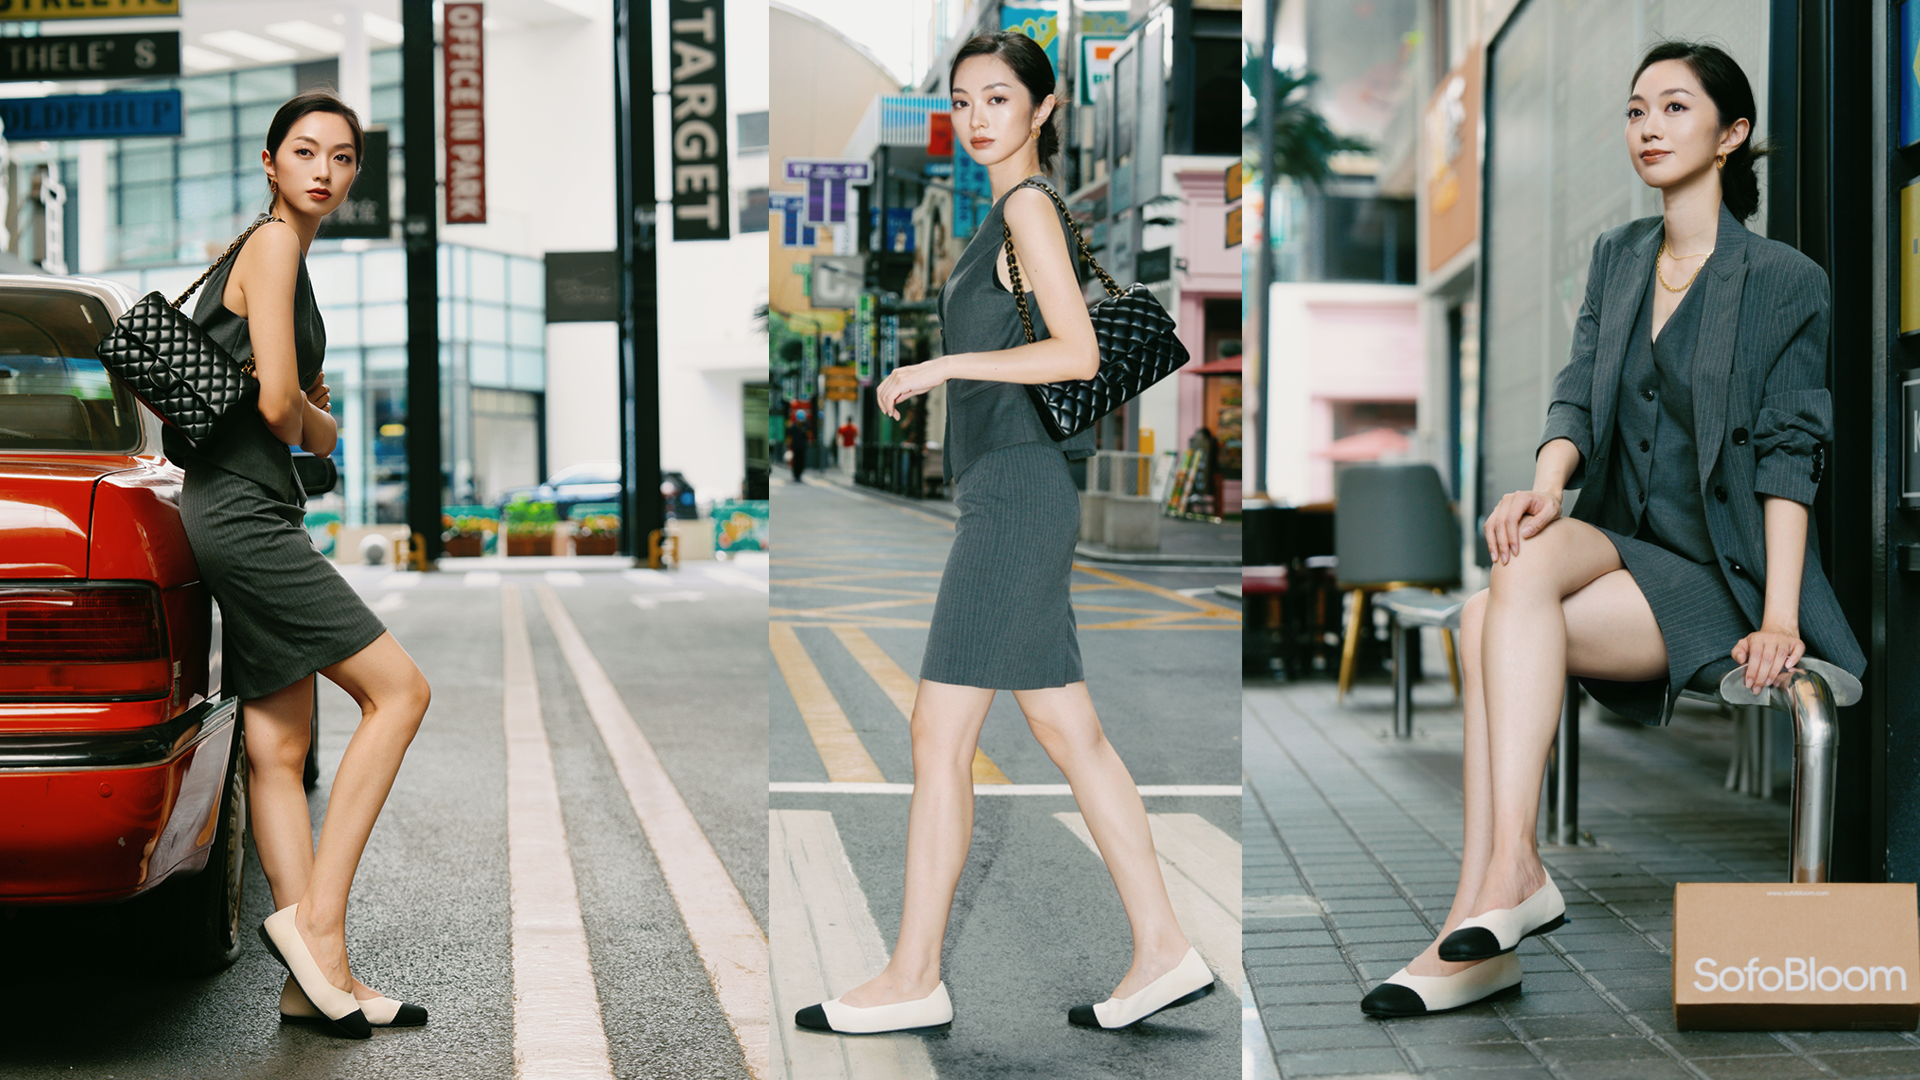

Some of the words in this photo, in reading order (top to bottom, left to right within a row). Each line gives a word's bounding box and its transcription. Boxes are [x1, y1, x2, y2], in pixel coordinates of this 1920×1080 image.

[448, 6, 481, 106] OFFICE
[450, 109, 481, 140] IN
[672, 0, 720, 231] TARGET
[450, 144, 482, 219] PARK
[1766, 889, 1830, 897] www.sofobloom.com
[1693, 956, 1907, 992] SofoBloom
